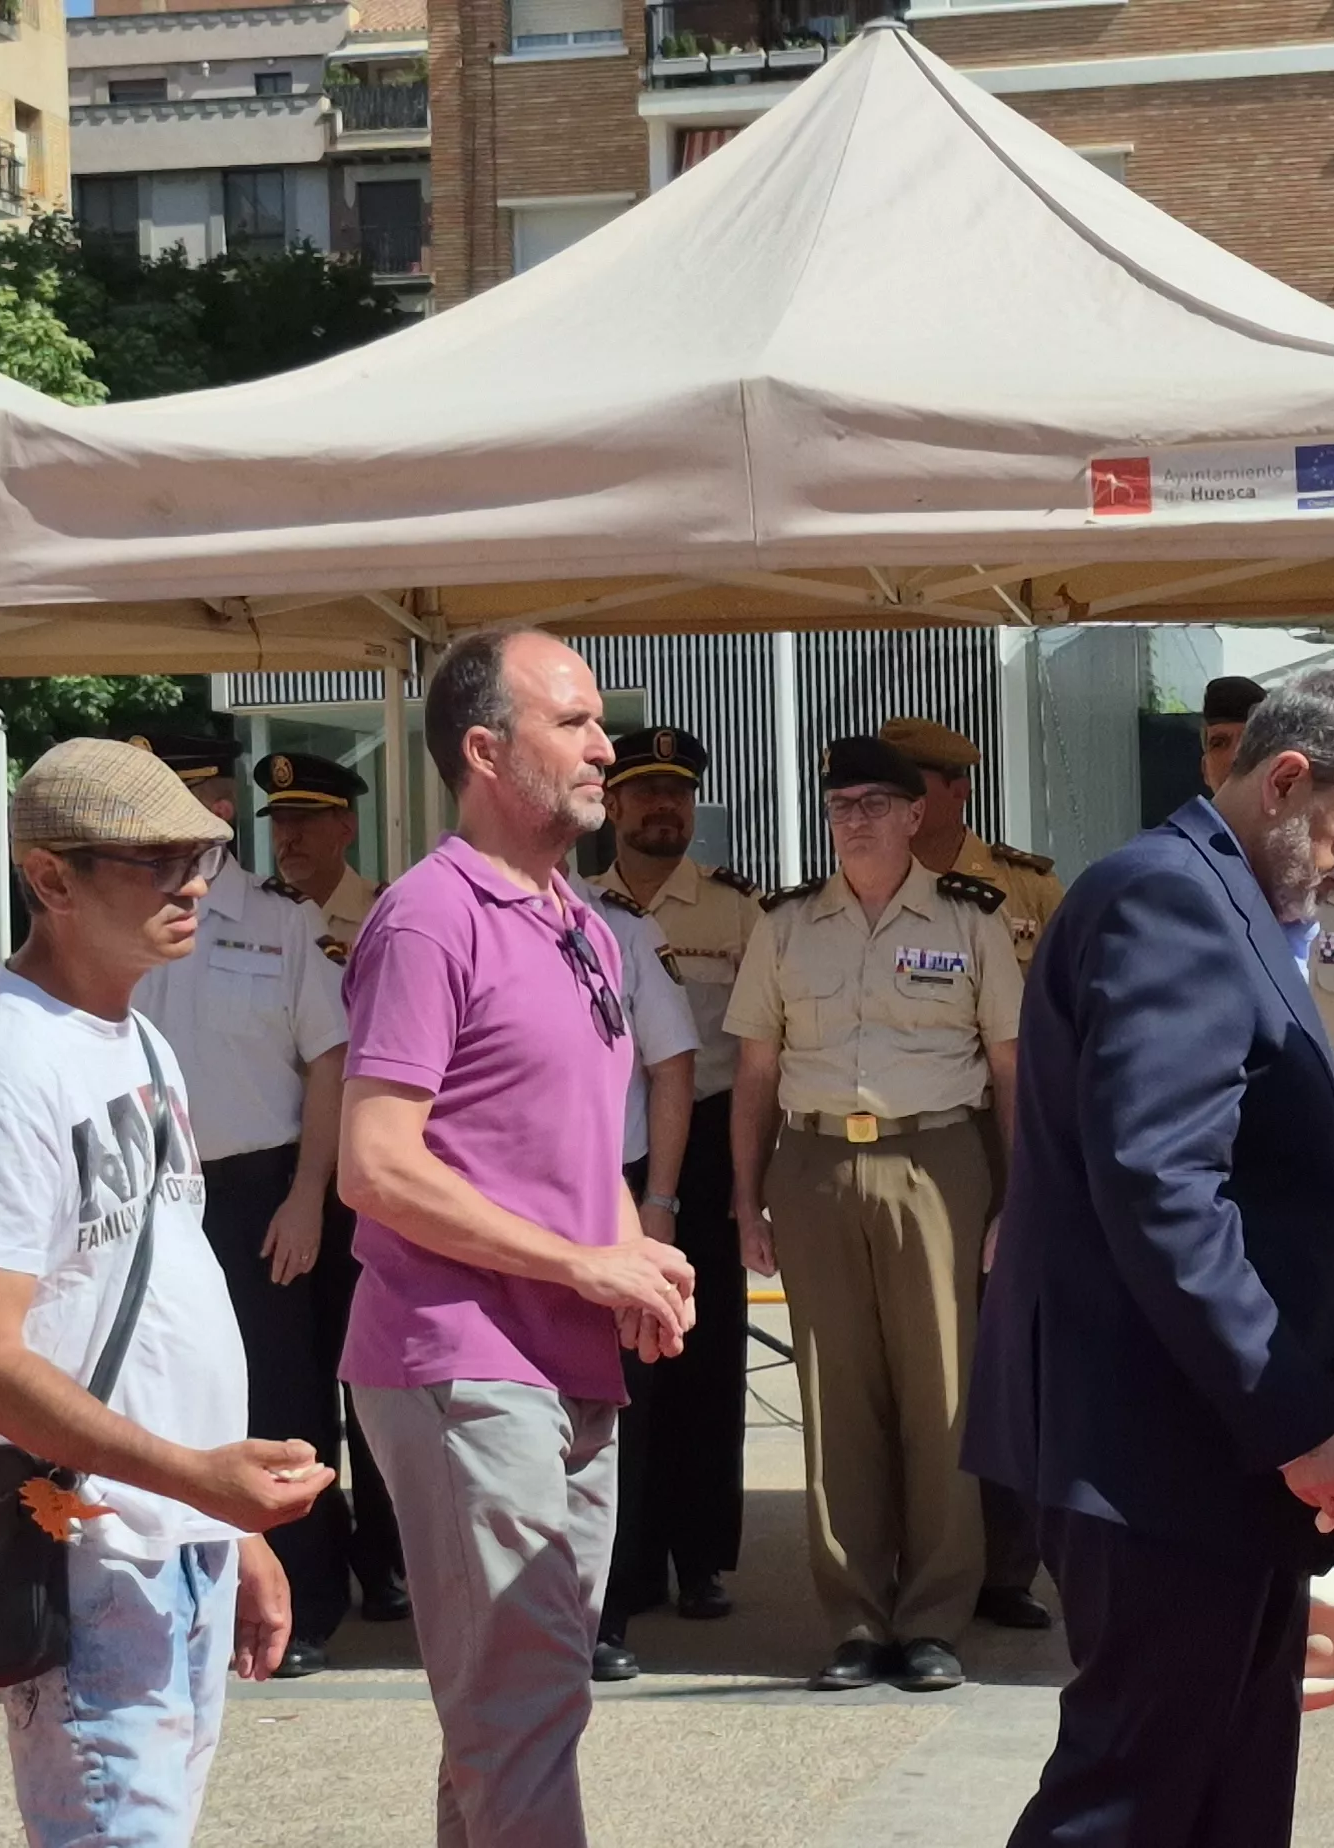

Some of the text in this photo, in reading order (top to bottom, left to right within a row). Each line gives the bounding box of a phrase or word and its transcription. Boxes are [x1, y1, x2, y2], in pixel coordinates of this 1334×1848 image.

[1164, 464, 1284, 487] Ayuntamiento
[1191, 486, 1257, 502] Huesca
[77, 1205, 139, 1252] FAMILY
